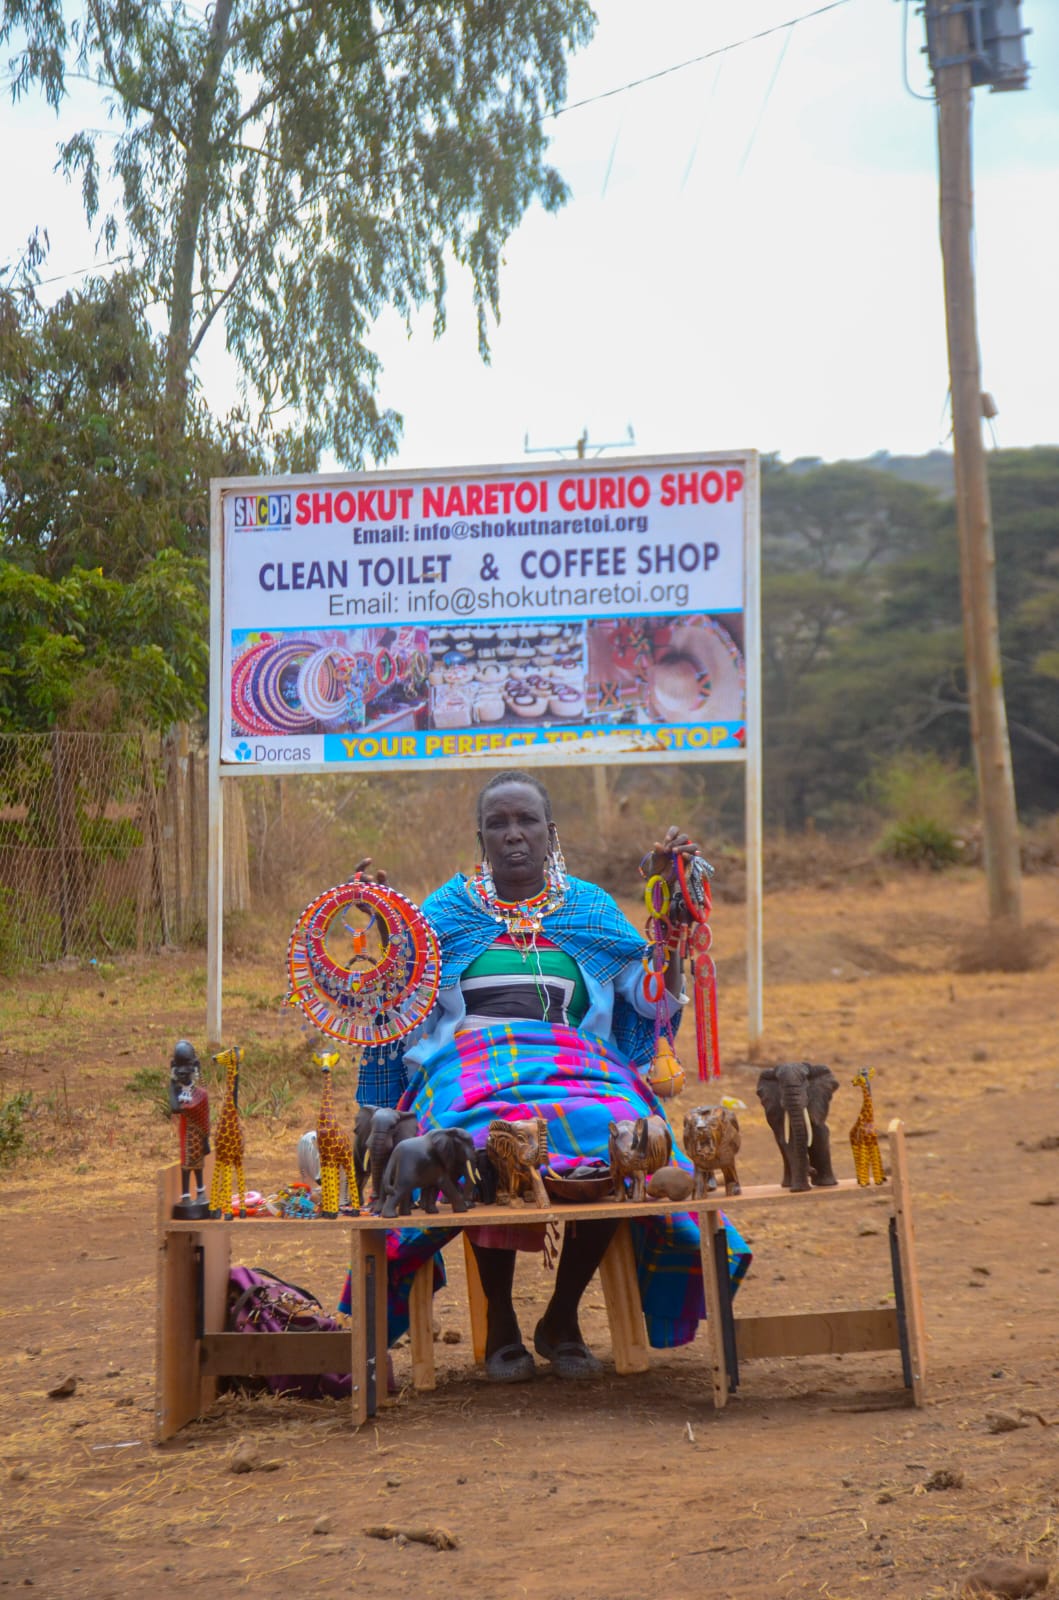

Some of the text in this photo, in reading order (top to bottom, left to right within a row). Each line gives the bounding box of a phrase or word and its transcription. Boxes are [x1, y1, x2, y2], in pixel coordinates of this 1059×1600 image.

[235, 496, 291, 526] SNCDP
[295, 470, 743, 526] SHOKUT NARETOI CURIO SHOP
[353, 515, 649, 545] Email: info@shokutnaretoi.org
[259, 542, 720, 591] CLEAN TOILET & COFFEE SHOP
[329, 580, 689, 616] Email: info@shokutnaretoi.org
[255, 745, 311, 761] Dorcas
[342, 736, 416, 758] YOUR
[425, 732, 536, 756] PERFECT
[656, 726, 728, 747] STOP
